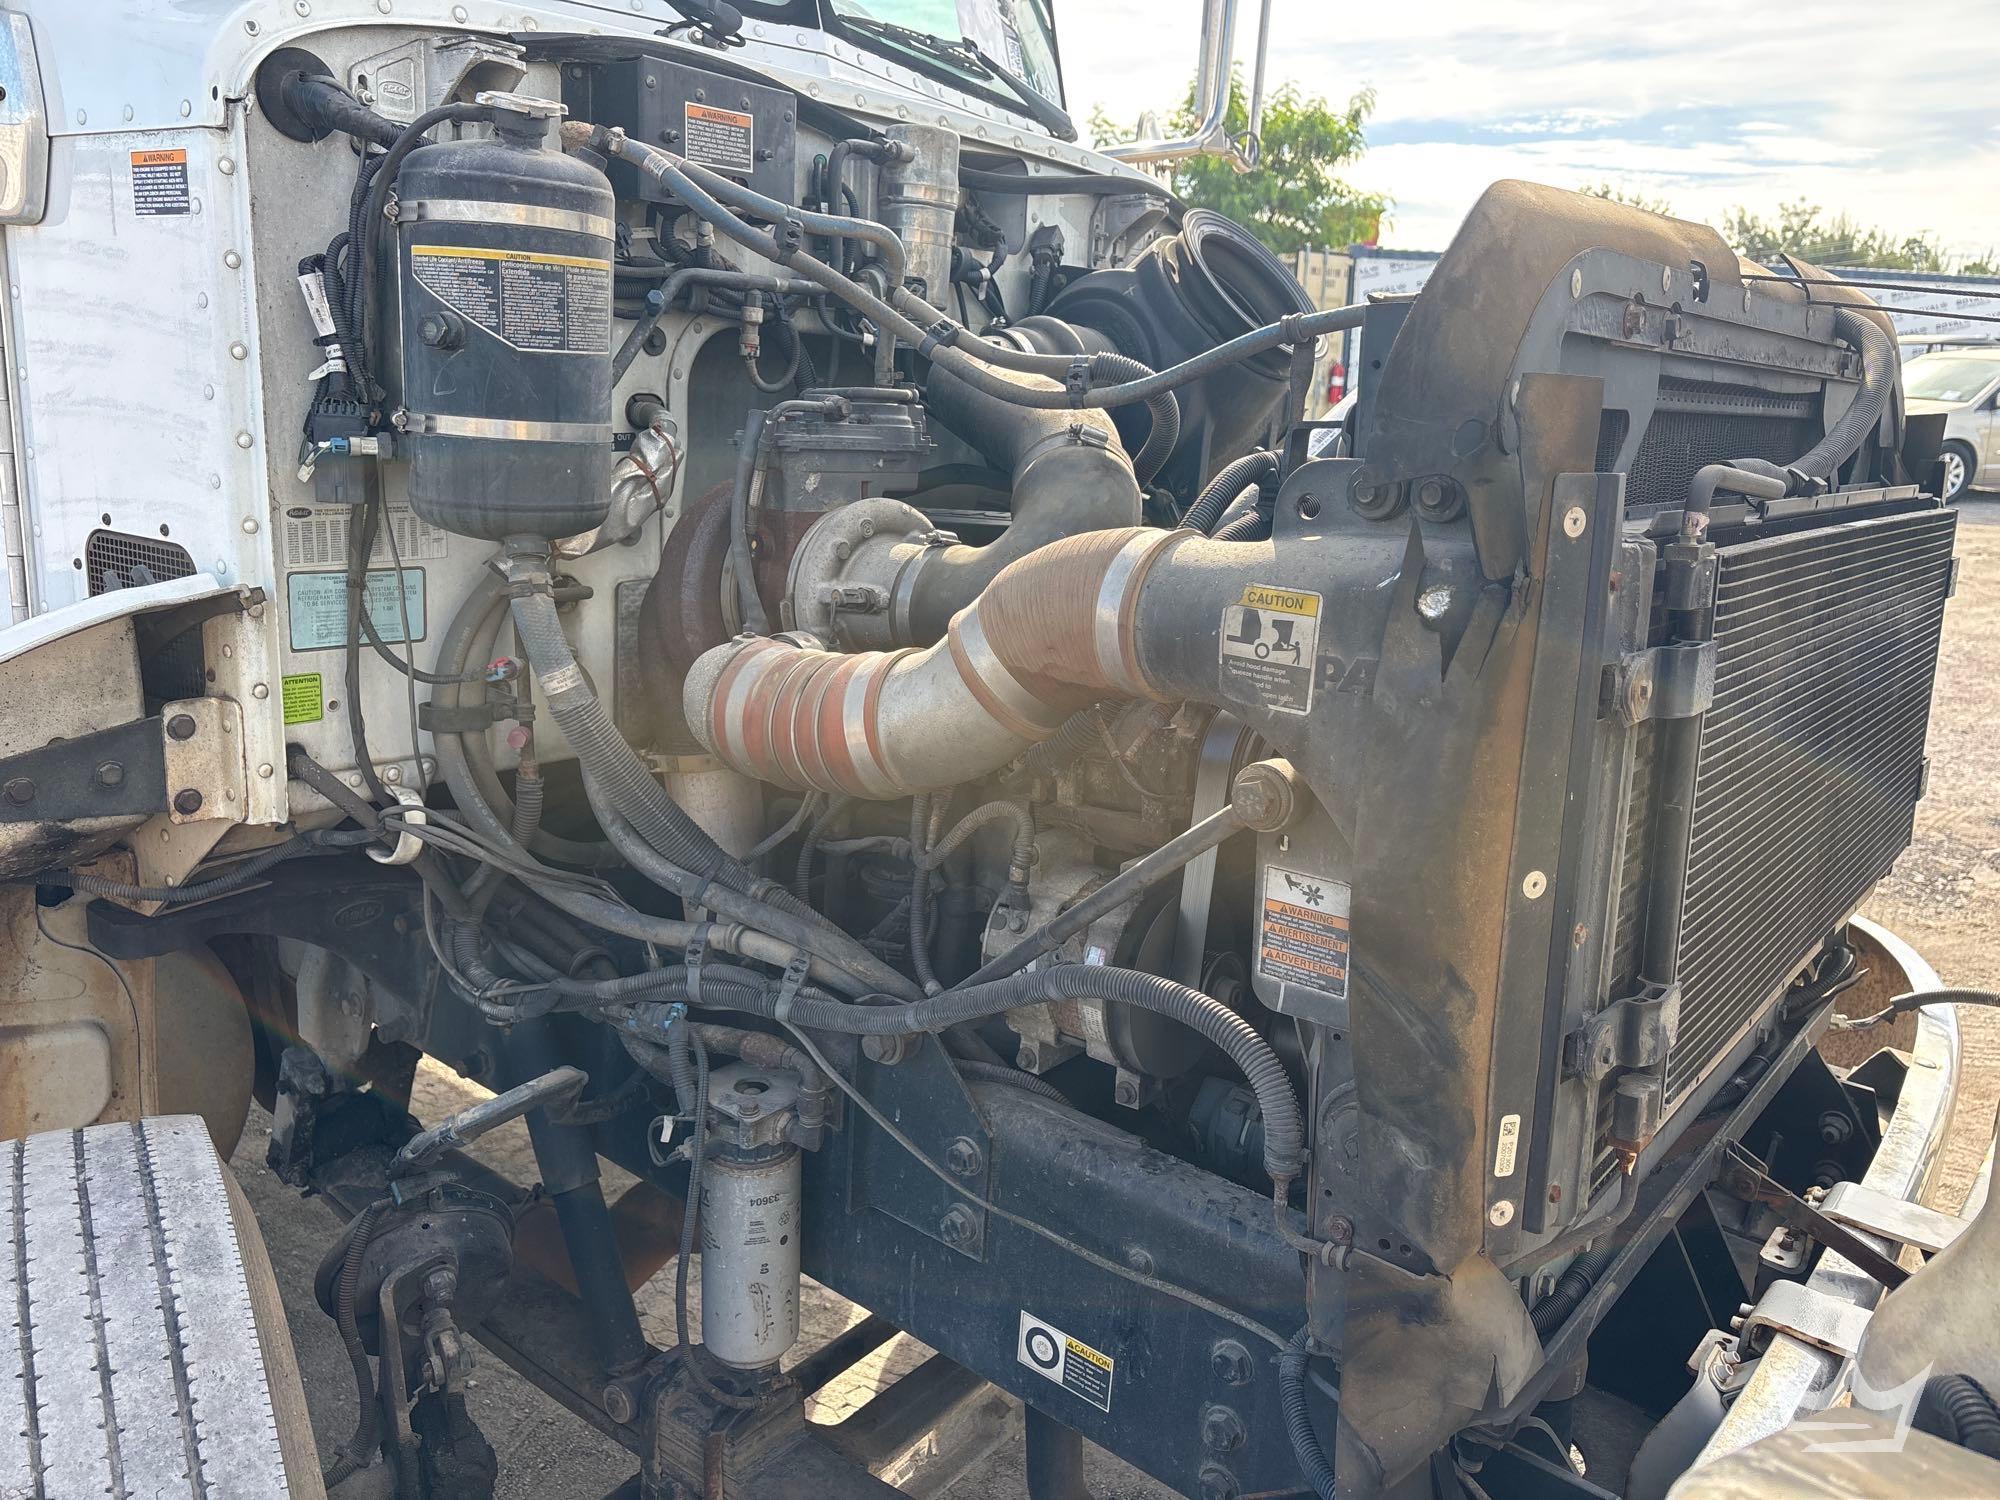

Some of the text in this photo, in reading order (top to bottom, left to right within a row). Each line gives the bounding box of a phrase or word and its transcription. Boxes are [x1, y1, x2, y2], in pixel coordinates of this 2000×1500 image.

[707, 111, 738, 124] WARNING
[148, 153, 174, 162] WARNING
[1248, 592, 1304, 610] CAUTION
[1229, 659, 1286, 676] Avoid hood damage
[284, 677, 318, 685] ATTENTION
[1253, 671, 1273, 681] handle
[1273, 676, 1290, 684] when
[1289, 906, 1334, 925] WARNING
[1279, 926, 1343, 951] AVERTISSEMENT
[1275, 952, 1341, 977] ADVERTENCIA
[750, 1193, 780, 1207] 33604
[1075, 1344, 1110, 1369] CAUTION
